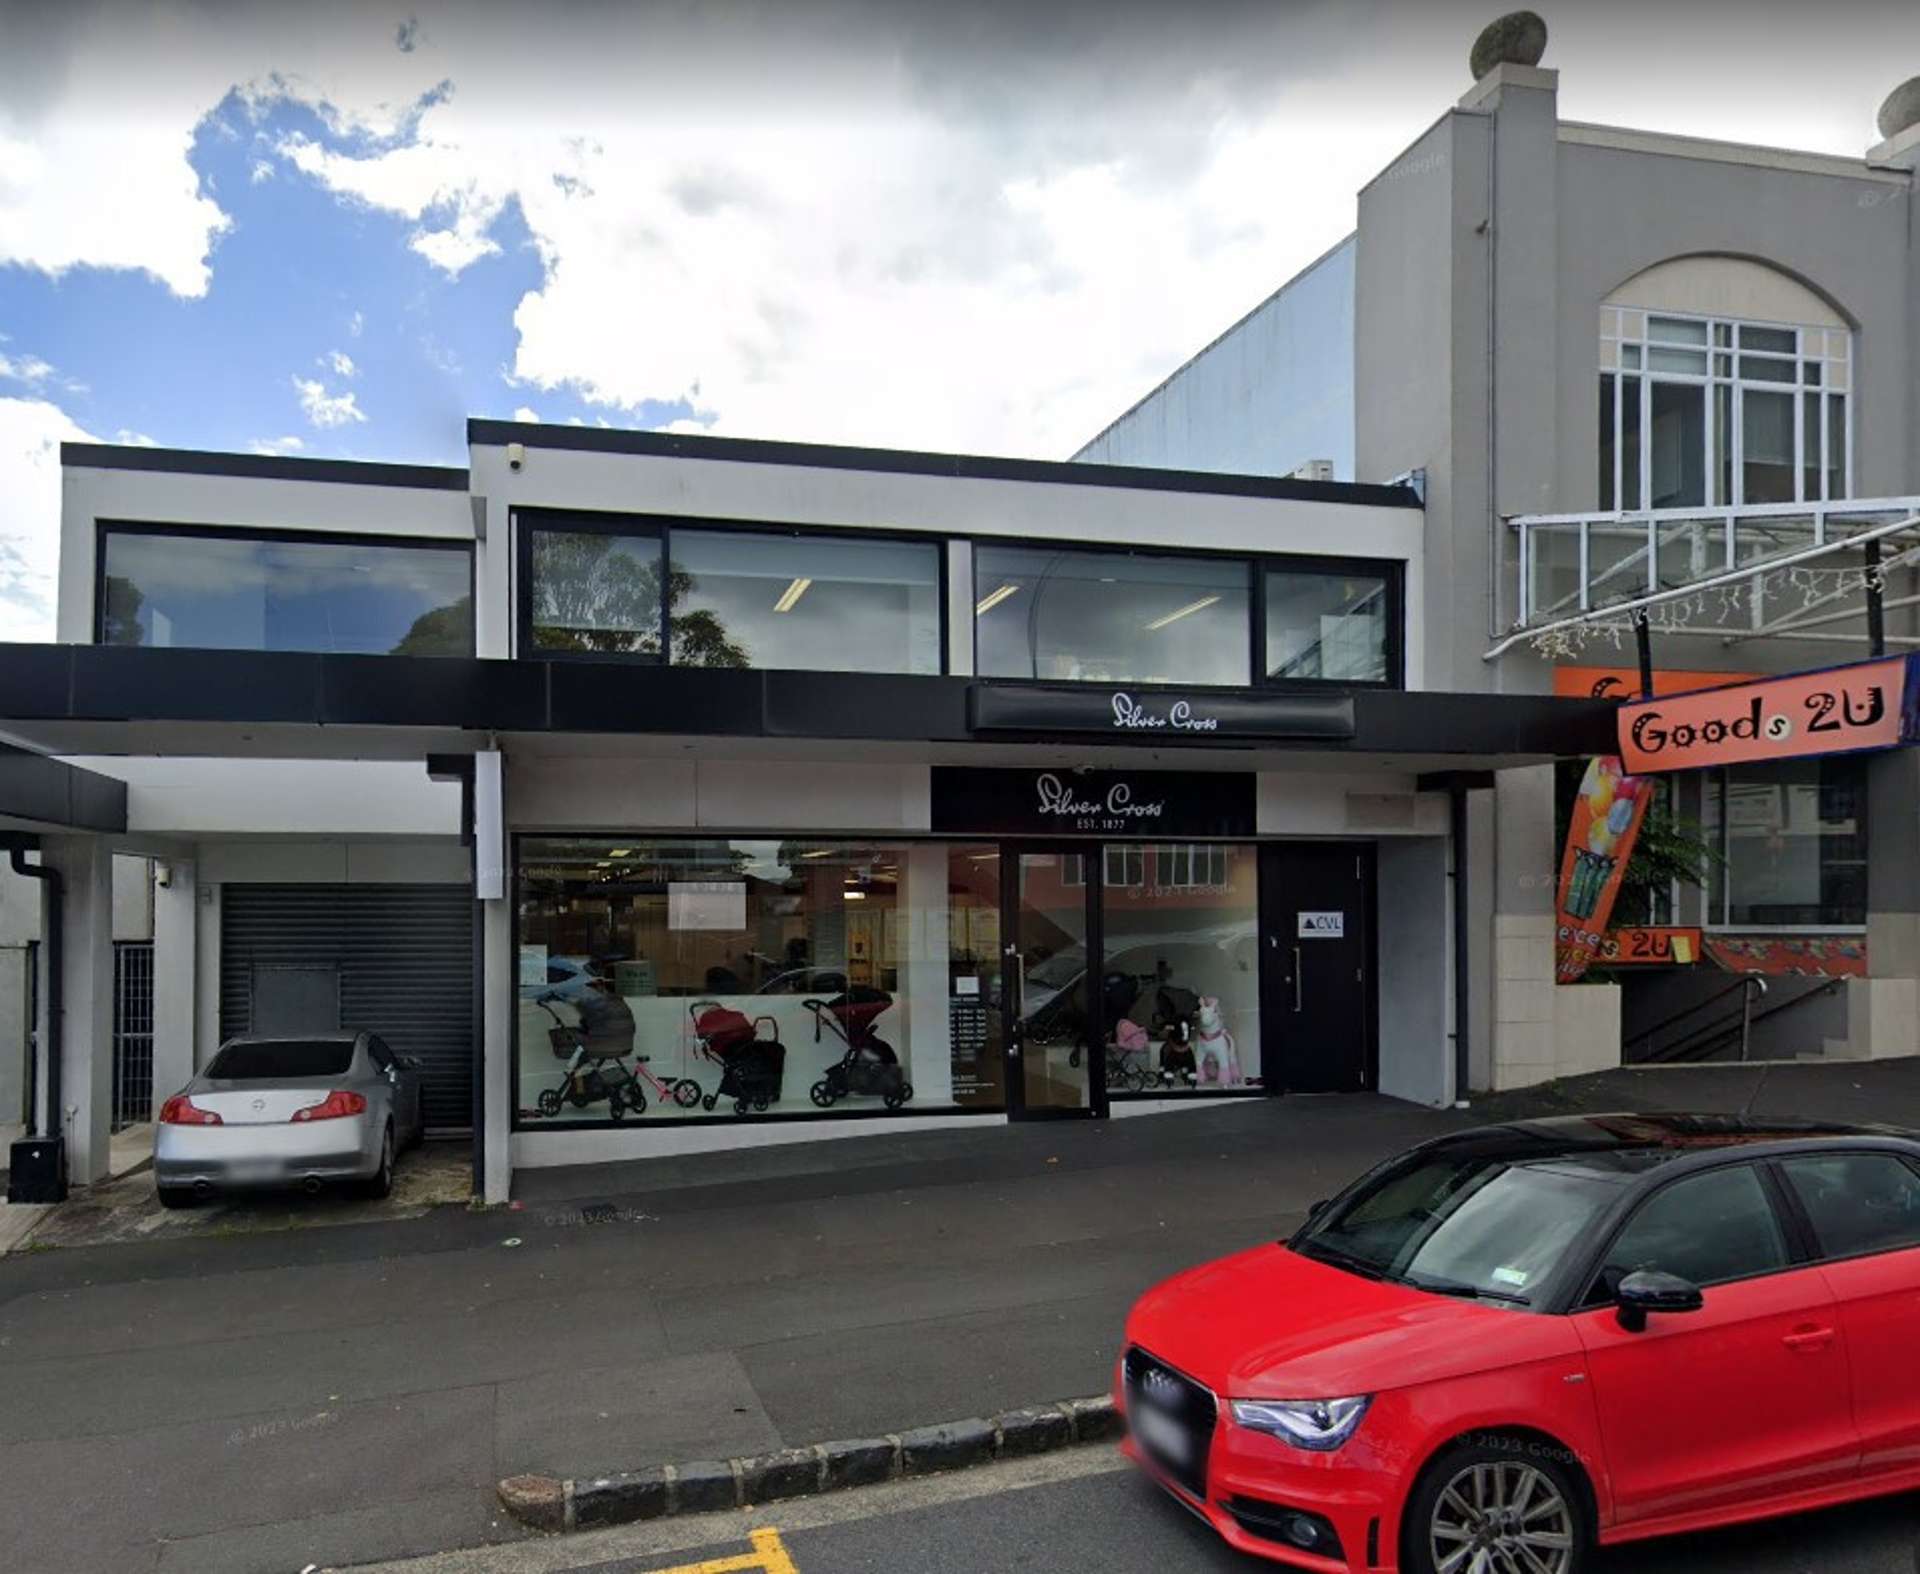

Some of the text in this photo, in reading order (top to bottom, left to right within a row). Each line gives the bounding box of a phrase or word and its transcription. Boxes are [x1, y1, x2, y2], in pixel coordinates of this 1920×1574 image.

[1111, 692, 1217, 730] Silver Cross
[1631, 686, 1885, 754] Goods 2U
[1036, 773, 1162, 817] Silver Cross
[1316, 915, 1341, 929] CVL
